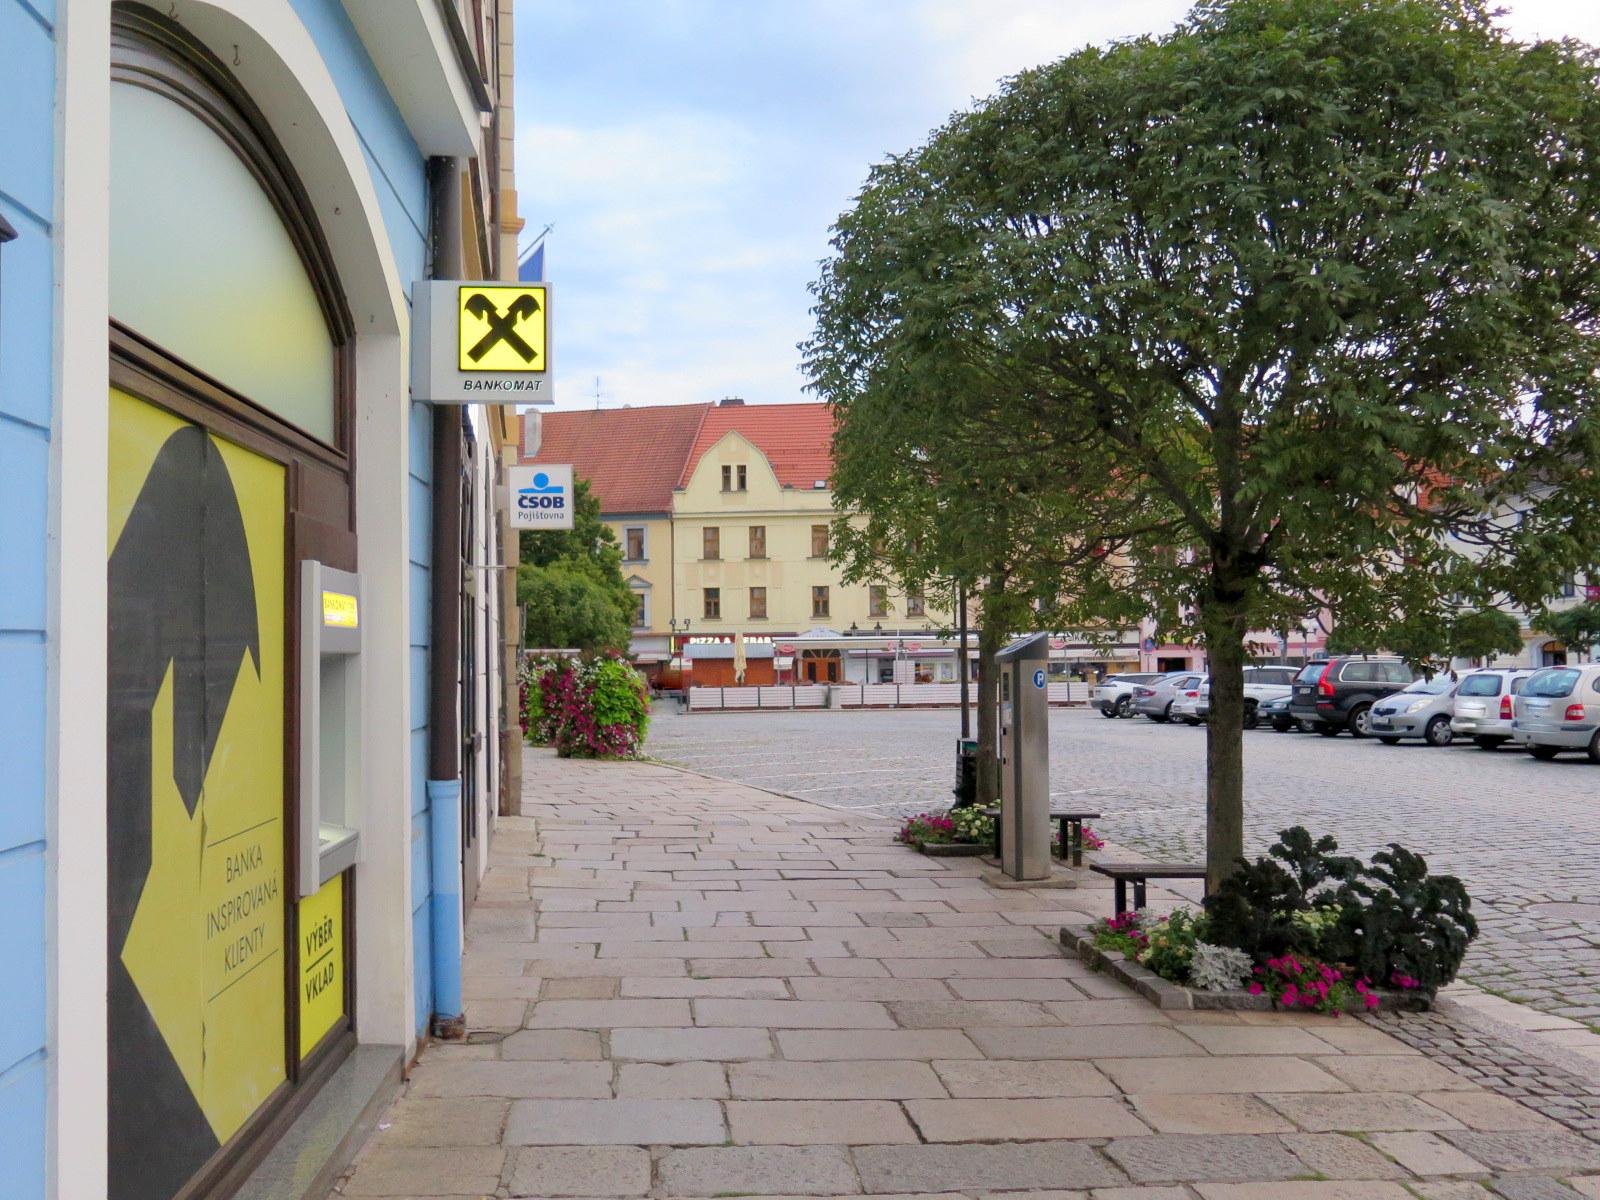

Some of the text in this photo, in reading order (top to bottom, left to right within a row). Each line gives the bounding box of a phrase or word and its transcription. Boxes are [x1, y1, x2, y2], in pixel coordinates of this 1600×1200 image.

[463, 380, 543, 391] BANKOMAT
[518, 494, 565, 509] ČSOB
[689, 637, 721, 645] PIZZA
[1037, 672, 1045, 685] P
[226, 844, 263, 883] BANKA
[207, 868, 278, 940] INSPIROVANÁ
[224, 922, 266, 976] KLIENTY
[306, 914, 333, 957] VÝBĚR
[306, 962, 334, 1003] VKLAD
